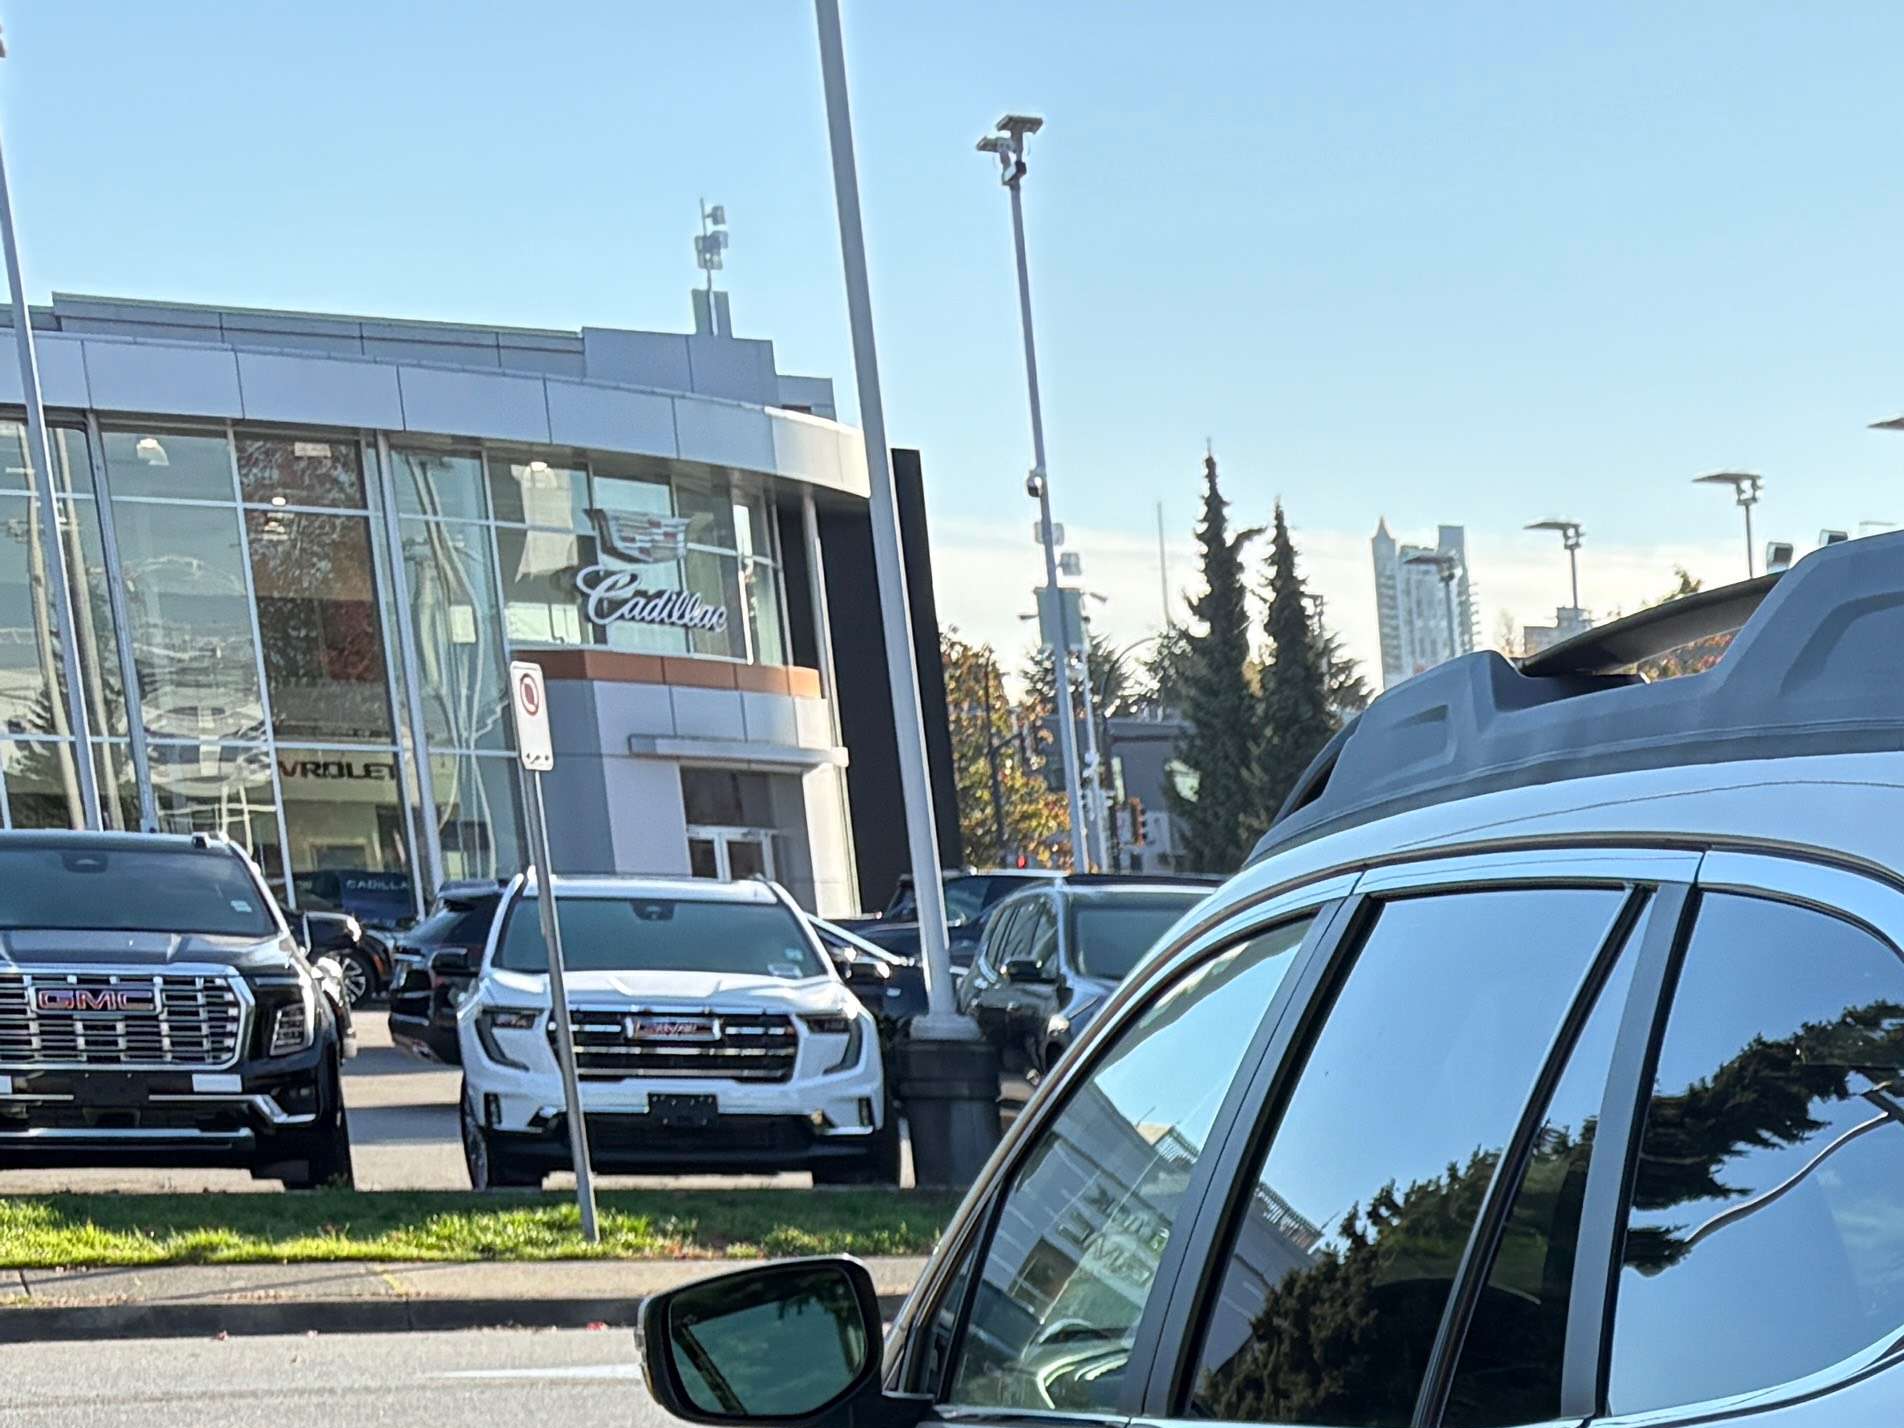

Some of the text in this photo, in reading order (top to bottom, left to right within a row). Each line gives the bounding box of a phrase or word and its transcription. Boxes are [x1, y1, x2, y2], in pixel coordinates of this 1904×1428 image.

[576, 565, 728, 633] Cadillac
[279, 760, 396, 781] VROLET
[346, 879, 409, 890] CADILLA
[38, 990, 154, 1011] GMC
